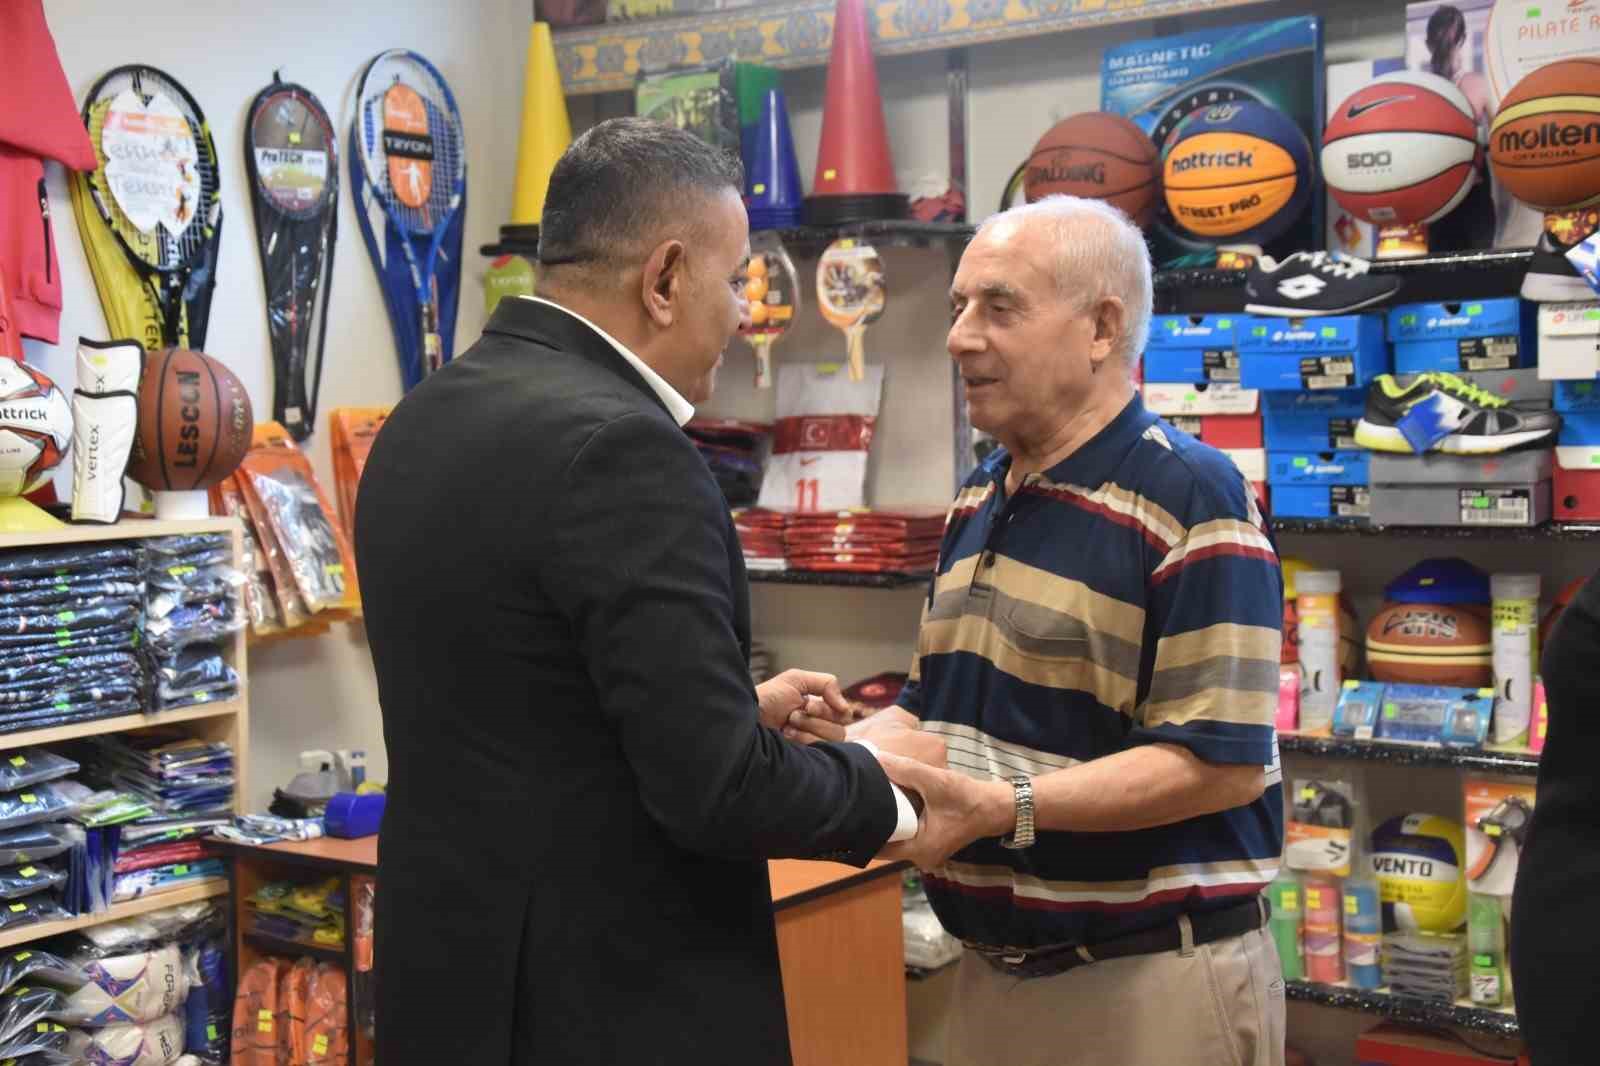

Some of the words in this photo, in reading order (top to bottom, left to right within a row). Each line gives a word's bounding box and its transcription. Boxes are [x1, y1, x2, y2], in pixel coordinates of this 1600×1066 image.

[1108, 42, 1213, 70] MAGNETIC
[1347, 150, 1392, 169] 500
[1177, 204, 1235, 219] STREET
[1239, 194, 1272, 215] PRO
[0, 407, 48, 420] ttrick
[87, 423, 100, 481] vertex
[1373, 856, 1433, 878] VENTO
